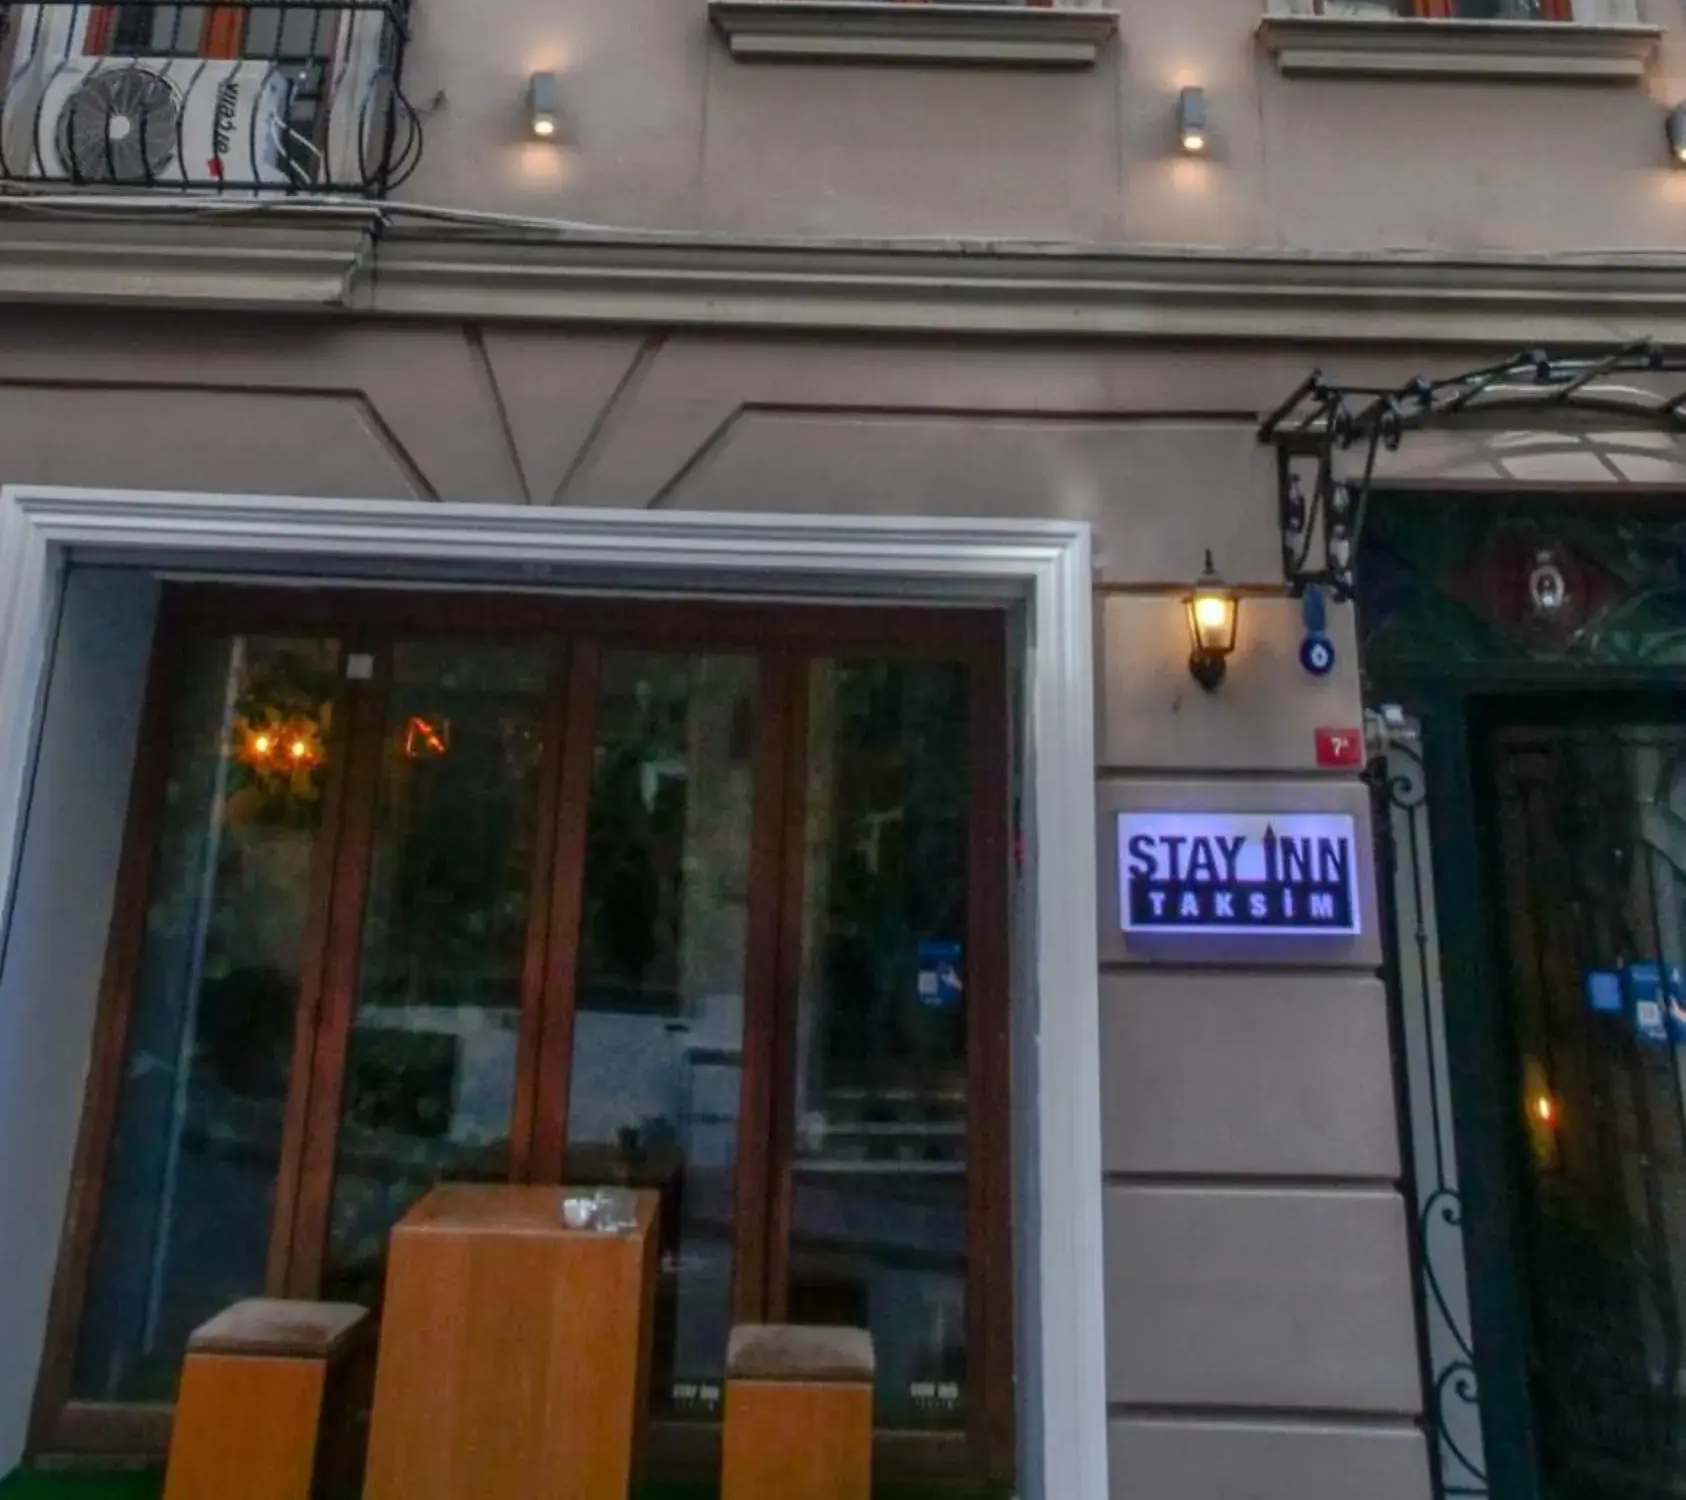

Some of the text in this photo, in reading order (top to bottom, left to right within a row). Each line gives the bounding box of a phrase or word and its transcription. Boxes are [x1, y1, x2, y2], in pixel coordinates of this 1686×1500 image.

[1128, 823, 1349, 882] STAY INN
[1149, 888, 1334, 918] TAKSİM
